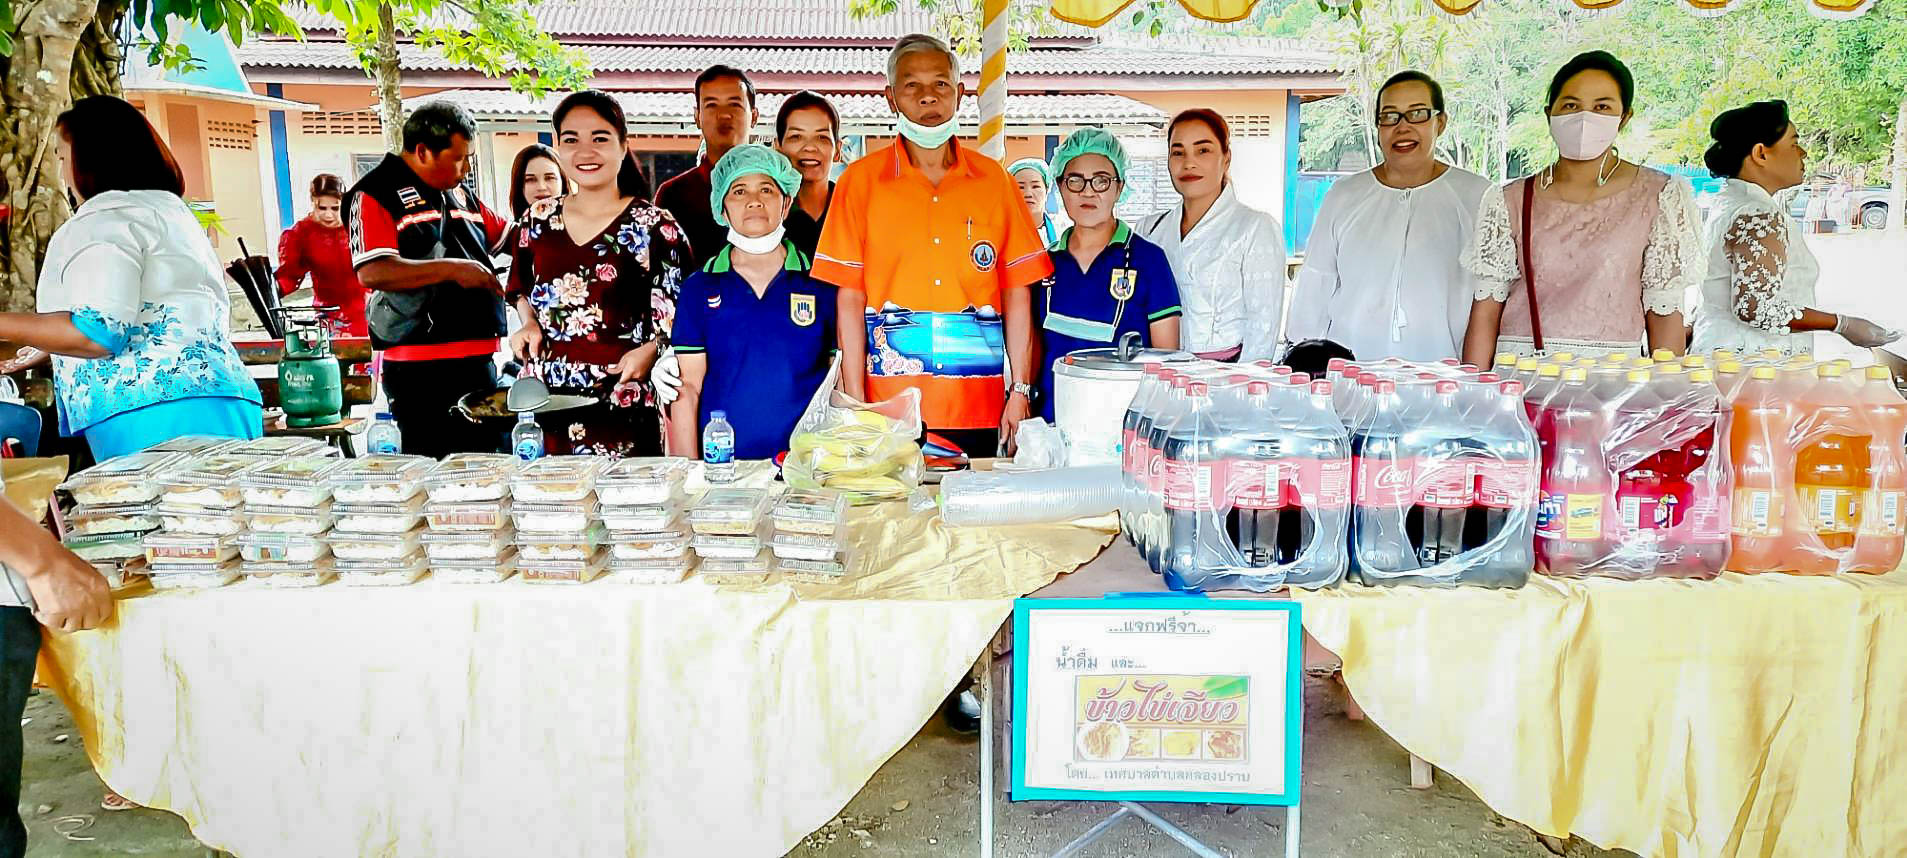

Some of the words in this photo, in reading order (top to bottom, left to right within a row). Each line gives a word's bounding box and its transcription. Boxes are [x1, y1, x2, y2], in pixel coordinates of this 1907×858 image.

[1056, 646, 1098, 669] น้ำดื่ม
[1085, 678, 1240, 723] ข้าวไข่เจียว
